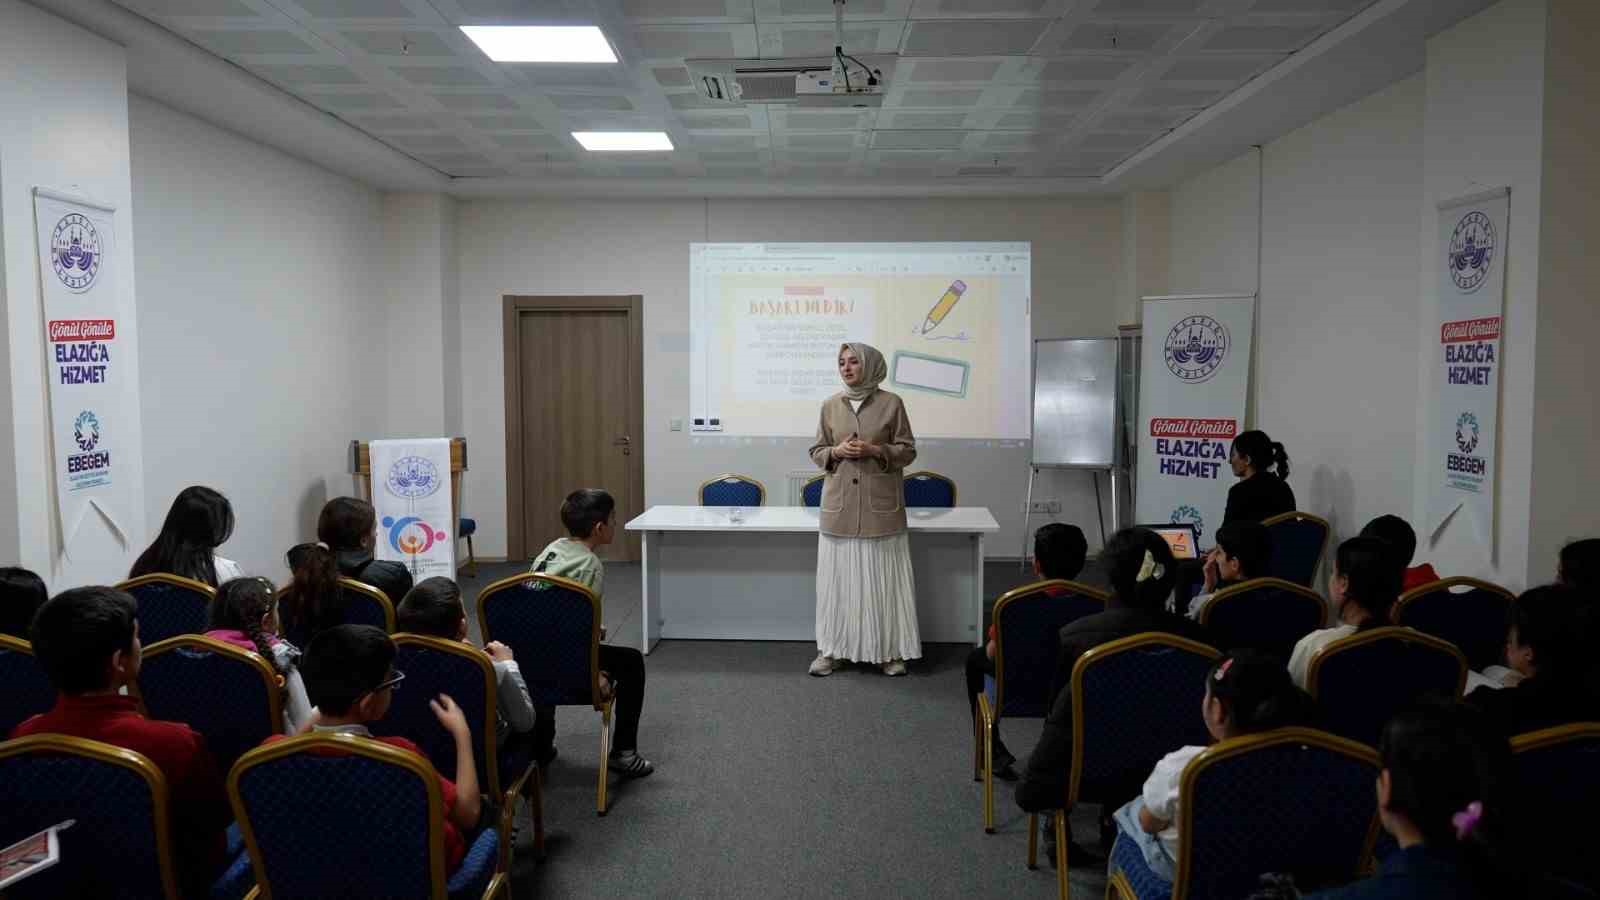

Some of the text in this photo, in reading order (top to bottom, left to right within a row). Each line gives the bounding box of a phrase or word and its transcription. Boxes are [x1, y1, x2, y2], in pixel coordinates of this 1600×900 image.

[52, 321, 113, 338] Gönül Gönüle
[1444, 322, 1469, 338] Gönül
[55, 341, 110, 363] ELAZIĞ'A
[1446, 341, 1495, 363] ELAZIĞ'A
[1153, 419, 1234, 437] Gönül Gönüle
[1156, 439, 1227, 460] ELAZIĞ'A
[68, 452, 110, 473] EBEGEM
[1447, 454, 1486, 475] EBEGEM
